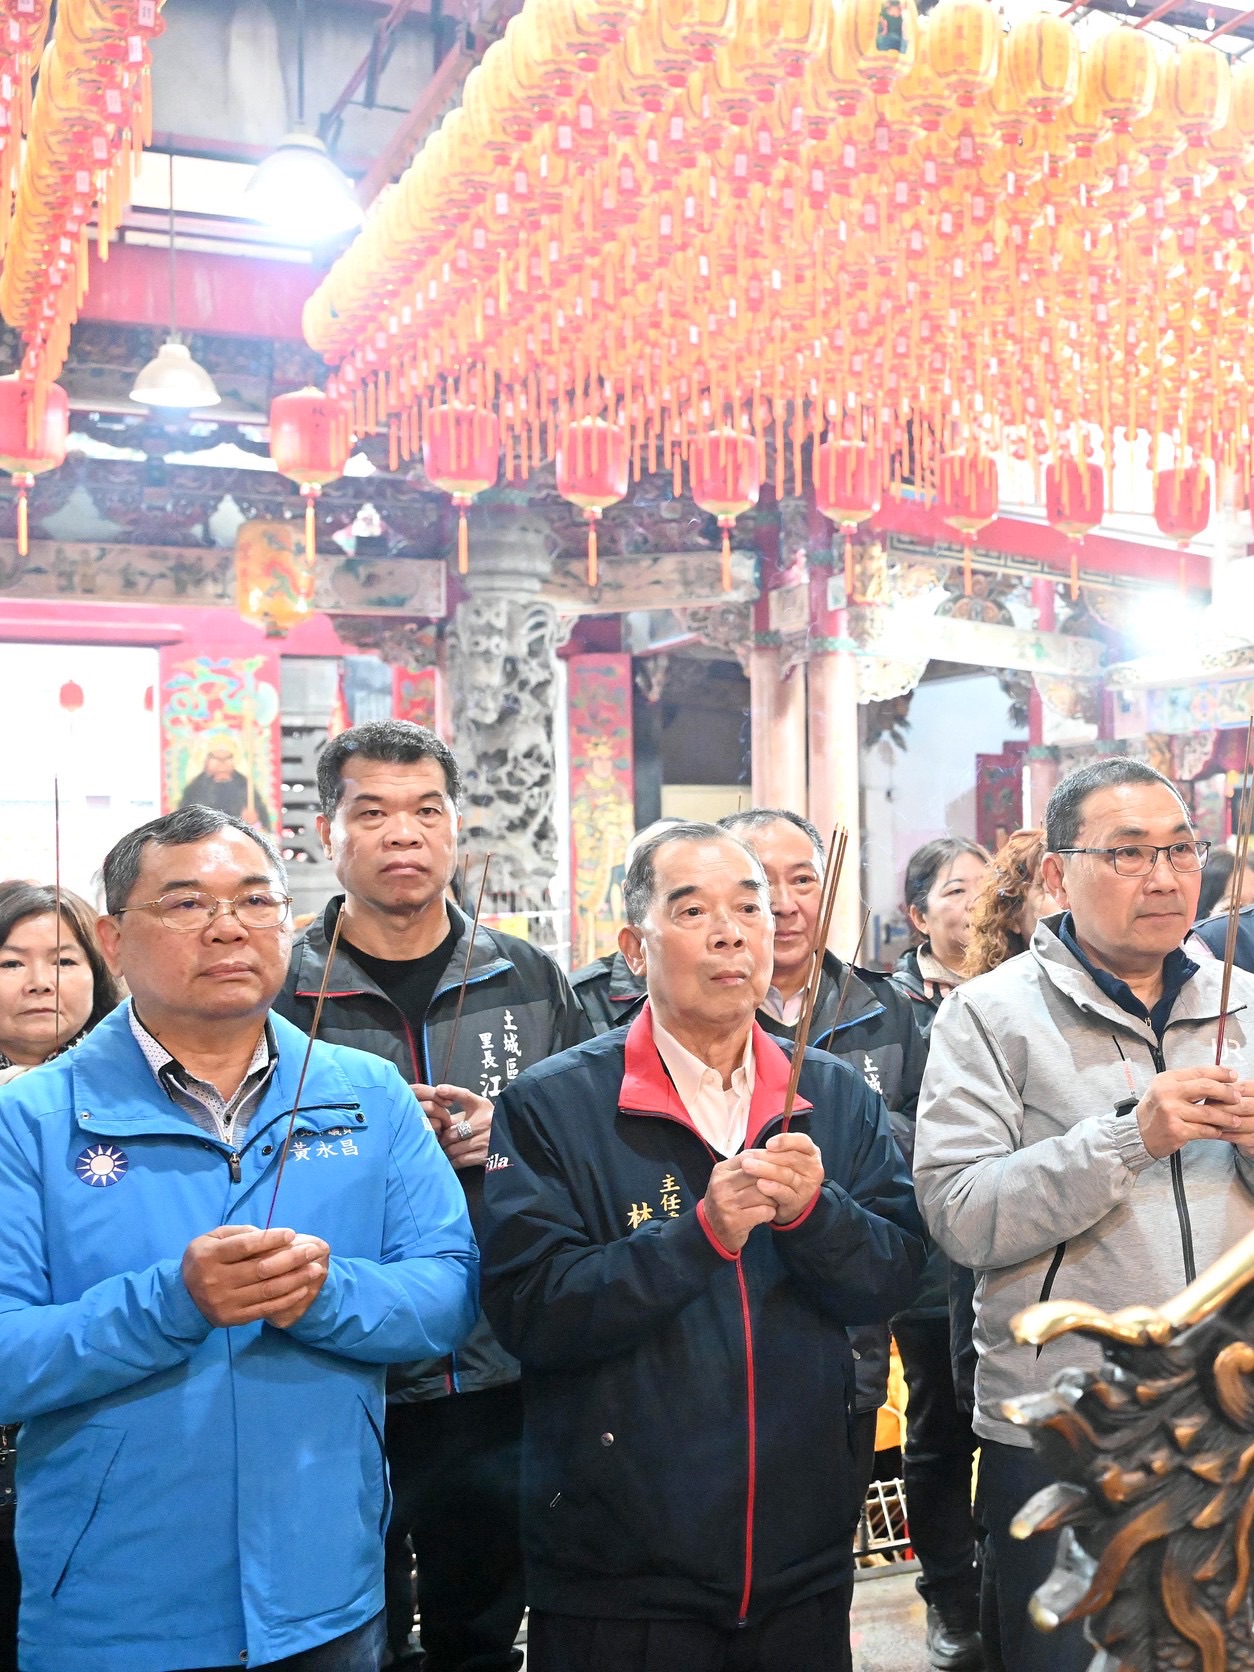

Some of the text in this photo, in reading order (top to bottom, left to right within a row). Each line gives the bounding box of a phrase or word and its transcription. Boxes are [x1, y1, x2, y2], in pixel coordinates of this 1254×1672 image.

[503, 1009, 522, 1085] 土城區
[289, 1138, 360, 1162] 黃永昌
